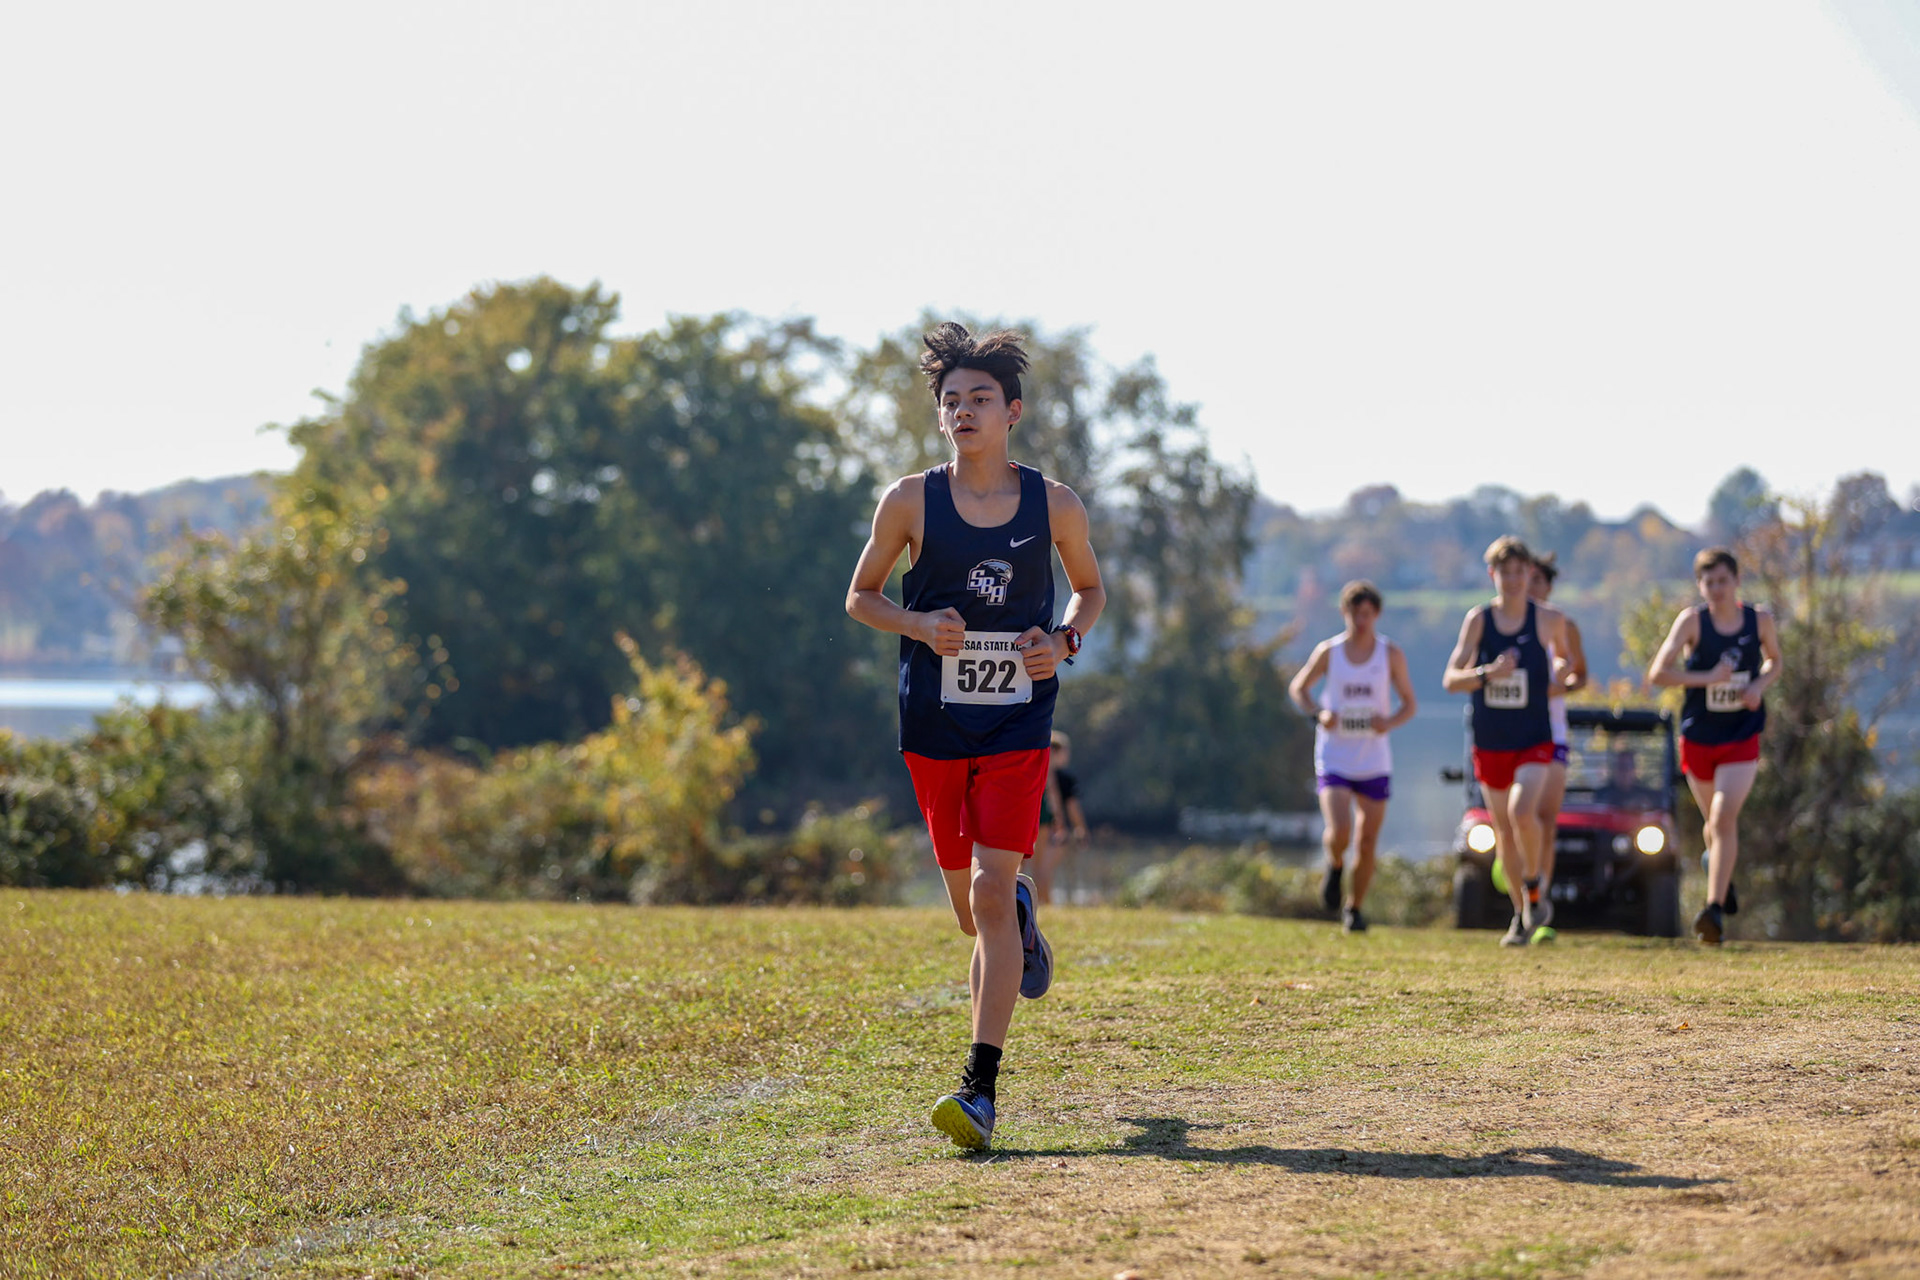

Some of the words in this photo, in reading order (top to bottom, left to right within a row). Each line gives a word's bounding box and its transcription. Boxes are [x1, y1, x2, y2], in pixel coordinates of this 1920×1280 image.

[969, 569, 1006, 605] SBA
[963, 640, 982, 651] SAA
[984, 641, 1009, 651] STATE
[957, 659, 1017, 694] 522
